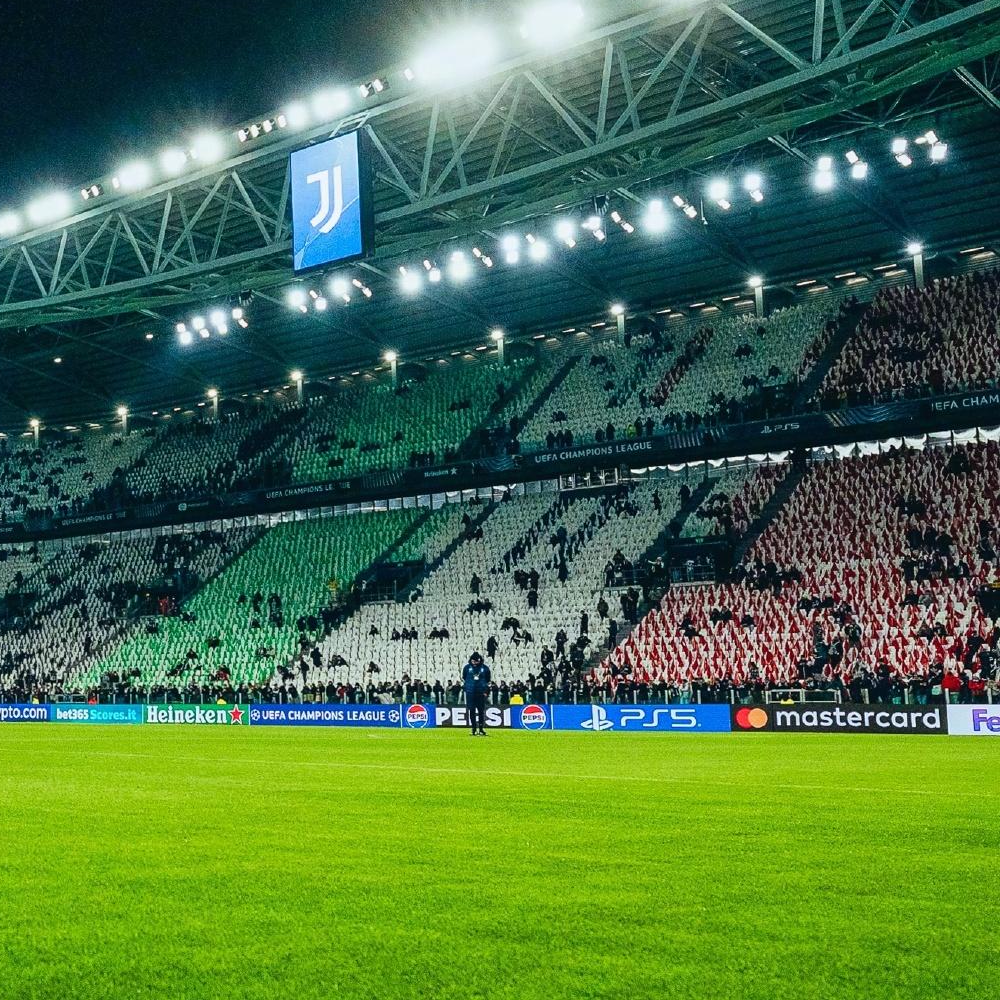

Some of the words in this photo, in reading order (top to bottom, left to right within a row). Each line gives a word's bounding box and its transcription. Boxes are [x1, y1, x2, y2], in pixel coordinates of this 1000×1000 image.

[962, 394, 1000, 407] CHAM
[774, 422, 800, 432] PS5
[534, 454, 558, 463] UEFA
[559, 446, 613, 460] CHAMPIONS
[615, 441, 652, 453] LEAGUE
[284, 485, 323, 497] CHAMPIONS
[146, 706, 228, 723] Heineken
[262, 710, 286, 720] UEFA
[288, 710, 344, 721] CHAMPIONS
[347, 711, 386, 721] LEAGUE
[436, 707, 511, 727] PESI
[619, 708, 696, 727] PS5
[776, 707, 941, 729] mastercard
[972, 709, 1000, 732] Fe
